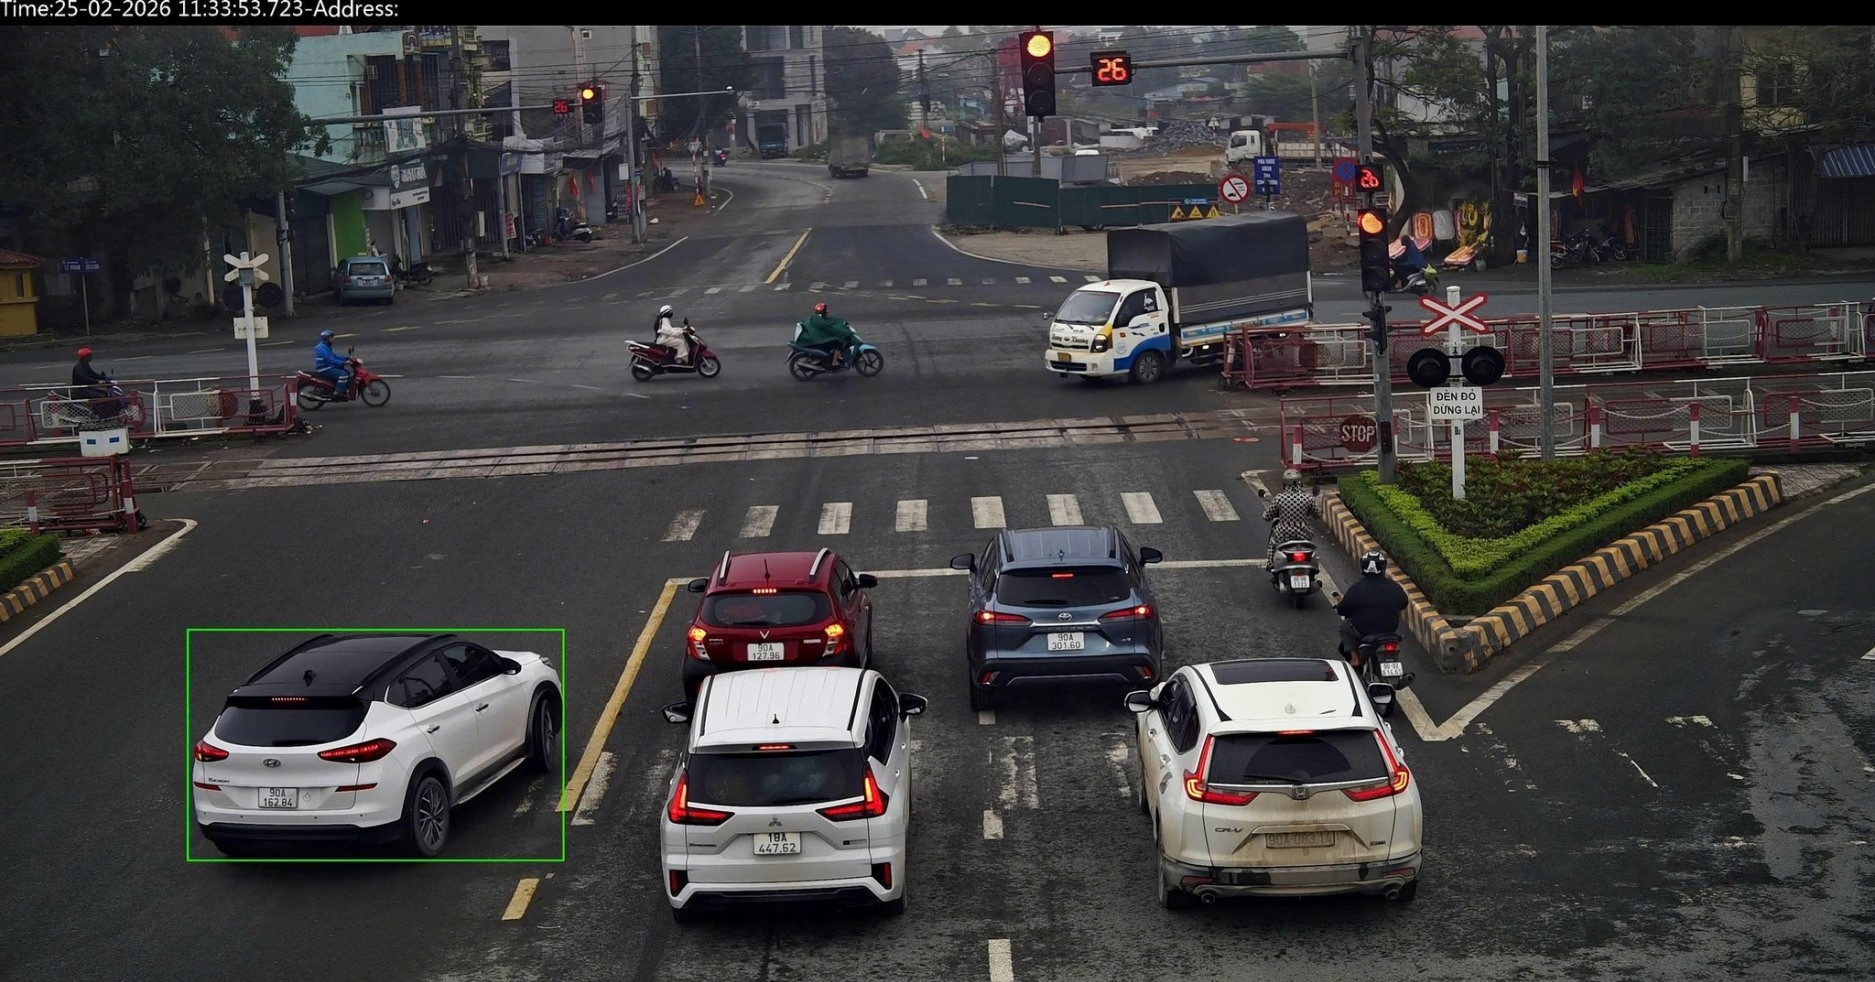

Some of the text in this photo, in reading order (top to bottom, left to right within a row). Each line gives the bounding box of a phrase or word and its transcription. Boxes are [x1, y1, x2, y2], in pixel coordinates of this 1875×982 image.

[1098, 58, 1127, 81] 26
[1436, 389, 1476, 401] ĐÈN ĐỎ
[1434, 403, 1480, 417] DỪNG LẠI
[1341, 425, 1375, 442] STOP
[758, 643, 774, 652] 90A
[1052, 641, 1081, 650] 301.60
[753, 652, 780, 660] 127.96
[269, 788, 286, 798] 90A
[263, 797, 293, 807] 162.84
[768, 832, 787, 842] 18A
[758, 843, 796, 853] 447.62
